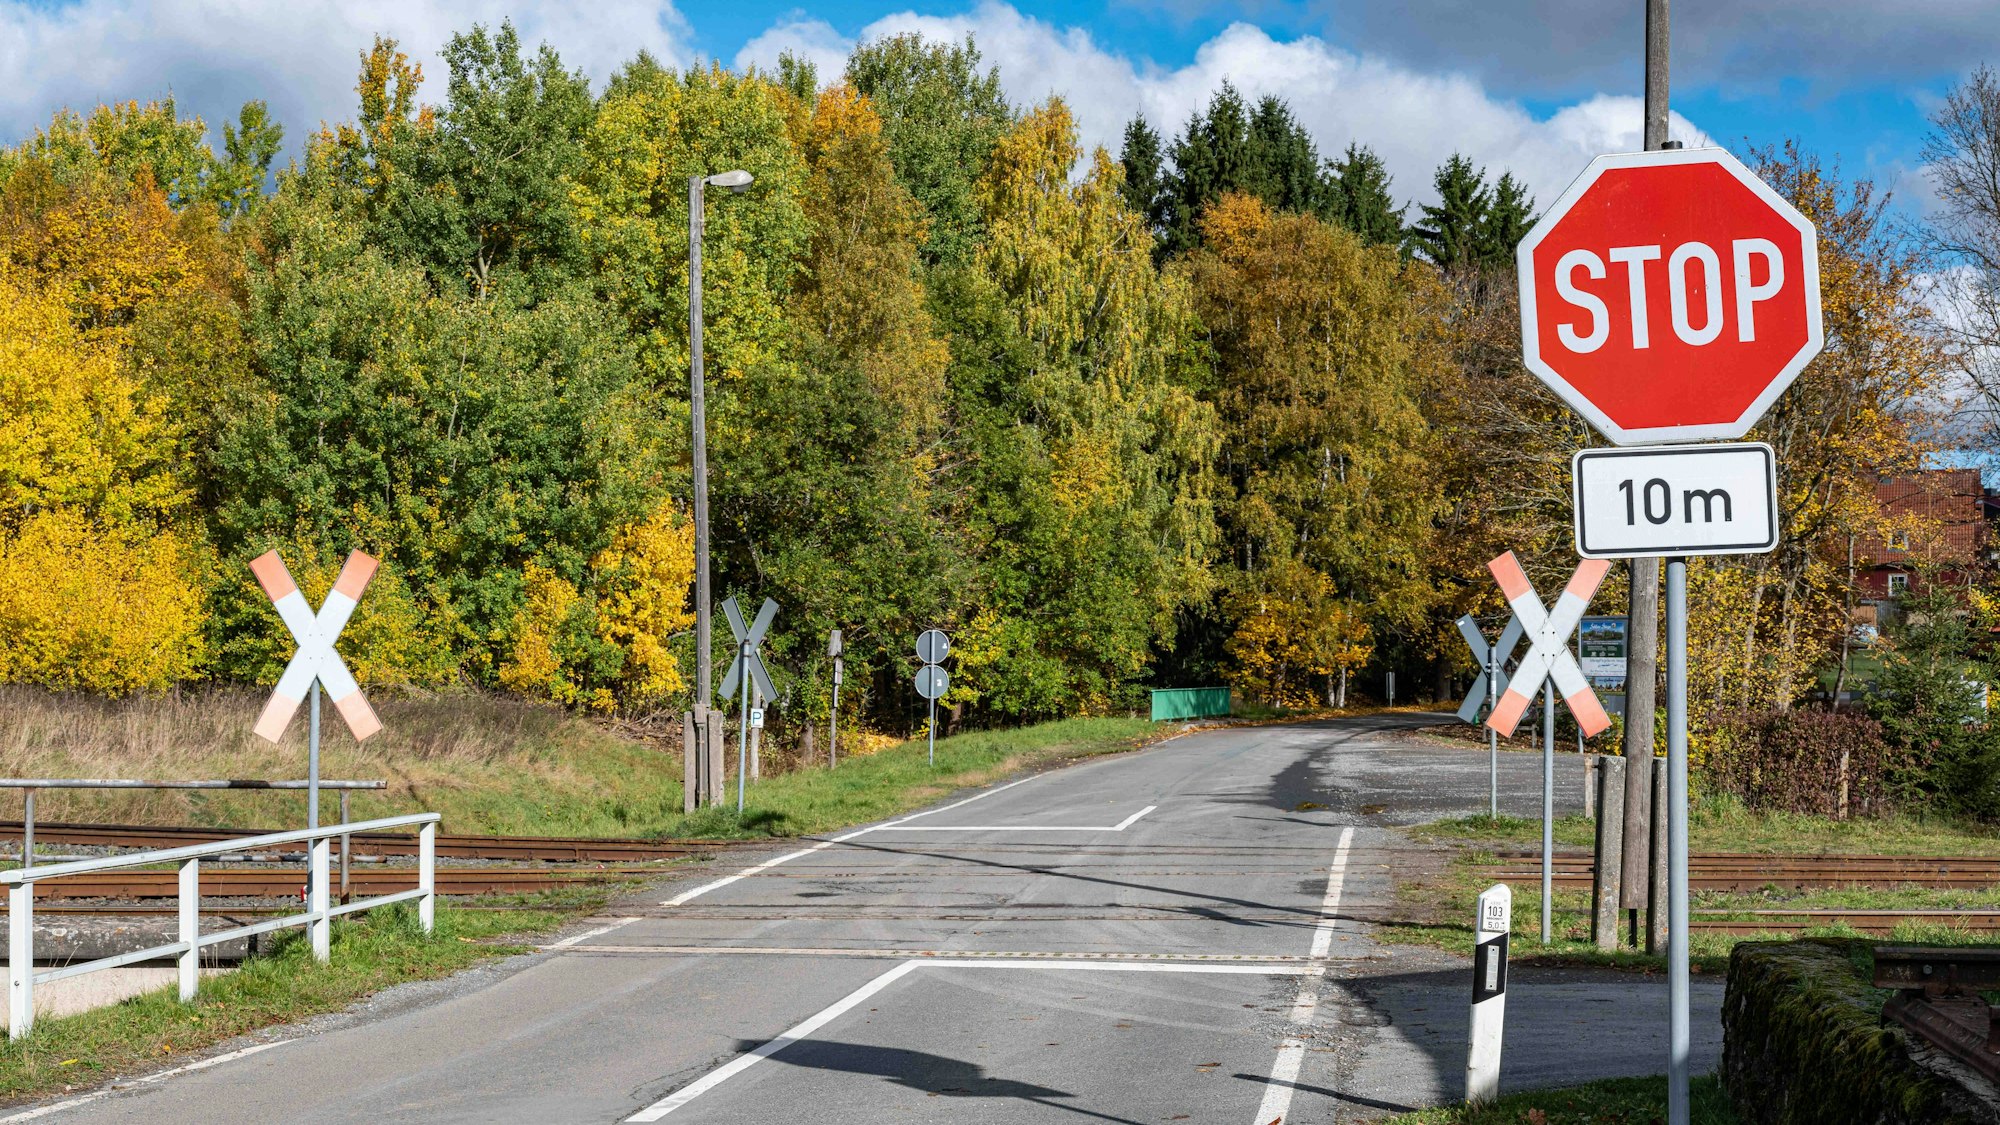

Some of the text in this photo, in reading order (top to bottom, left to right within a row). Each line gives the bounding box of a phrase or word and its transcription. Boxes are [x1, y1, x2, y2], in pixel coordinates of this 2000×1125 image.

[1555, 238, 1784, 354] STOP
[753, 711, 762, 725] P
[1488, 905, 1503, 917] 103
